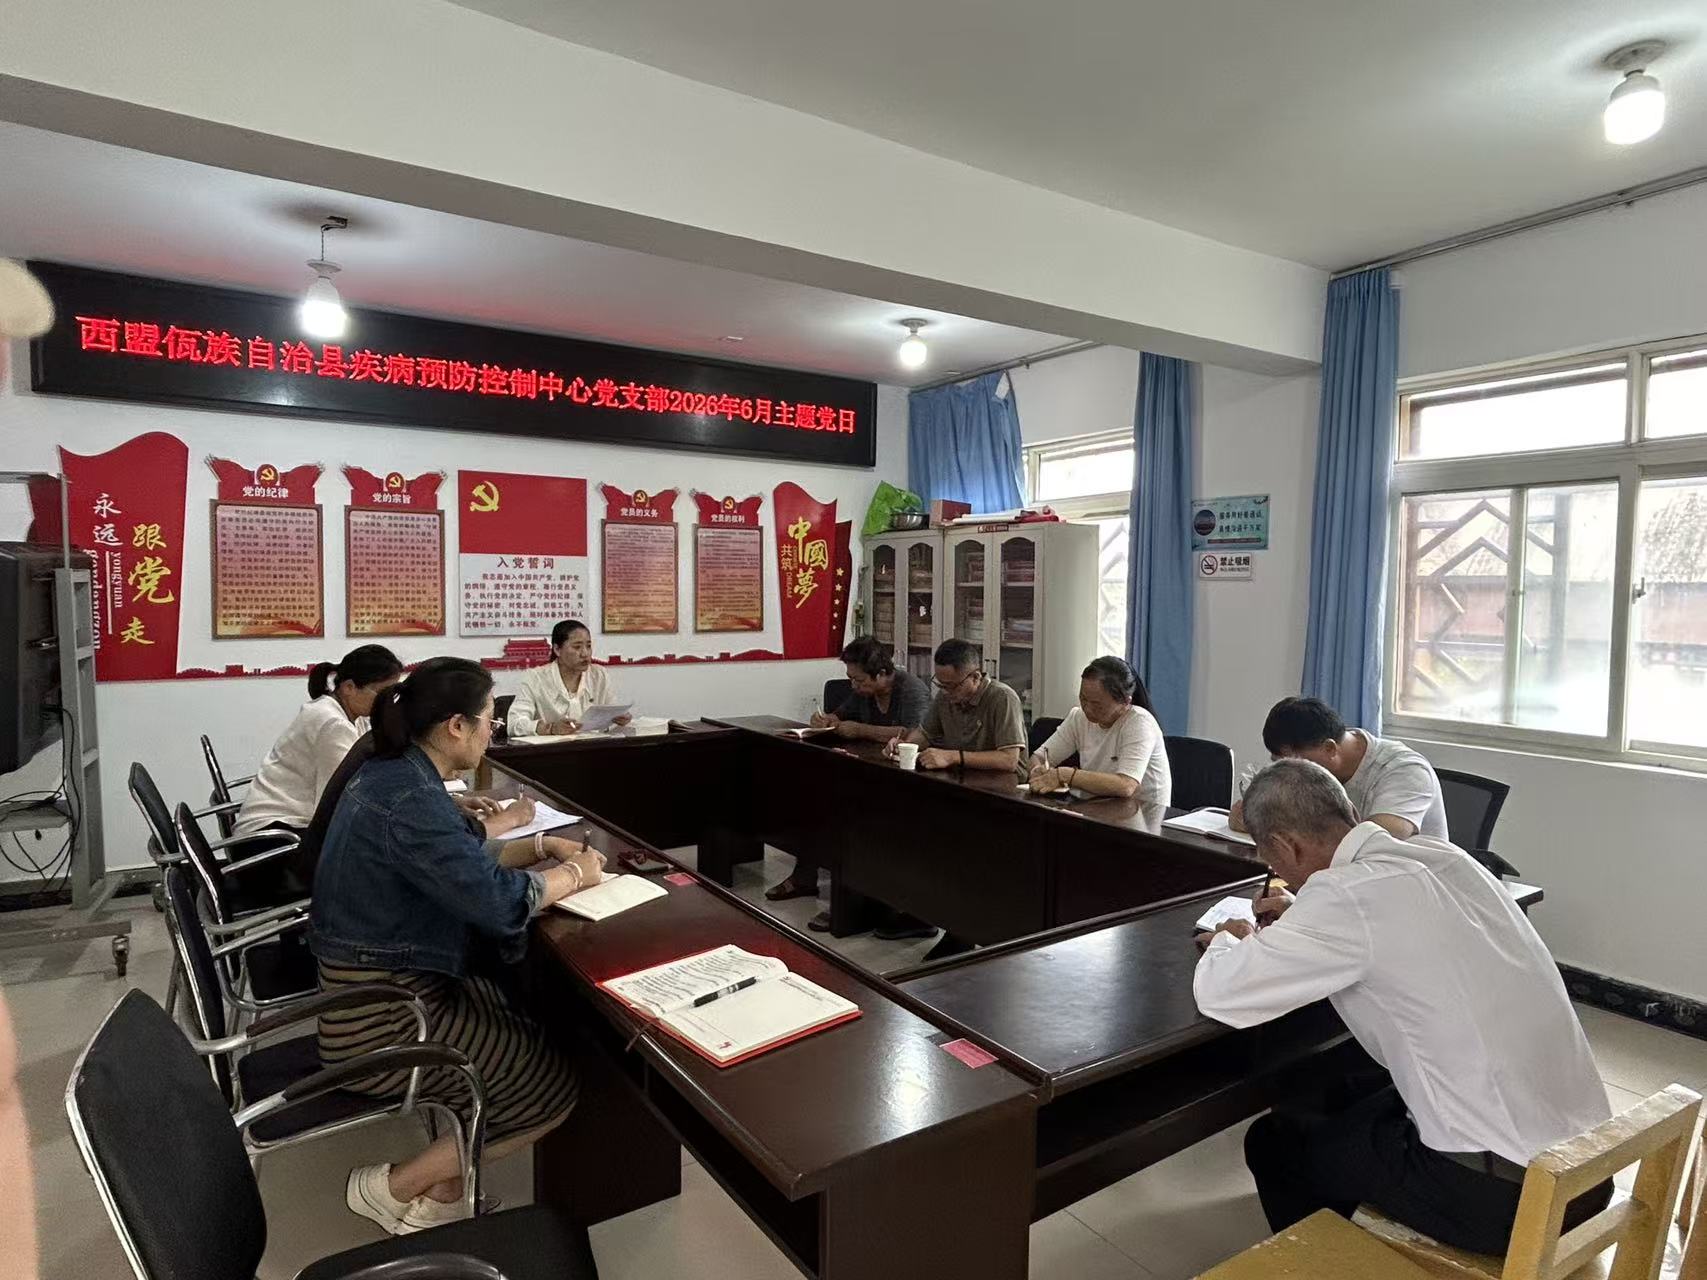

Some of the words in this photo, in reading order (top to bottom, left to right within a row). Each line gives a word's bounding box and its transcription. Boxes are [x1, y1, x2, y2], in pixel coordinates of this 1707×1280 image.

[76, 315, 857, 435] 西盟佤族自治县疾病预防控制中心党支部2026年6月主题党日
[242, 486, 290, 499] 党的纪律
[372, 493, 412, 504] 党的宗旨
[92, 493, 124, 546] 永远
[620, 508, 659, 518] 党员的义务
[711, 514, 745, 523] 党员的权利
[497, 557, 554, 570] 入党誓词
[780, 544, 794, 571] 共筑
[787, 516, 829, 608] 中國夢
[1219, 556, 1250, 566] 禁止吸烟
[111, 551, 123, 608] yongyuan
[121, 523, 175, 645] 跟党走
